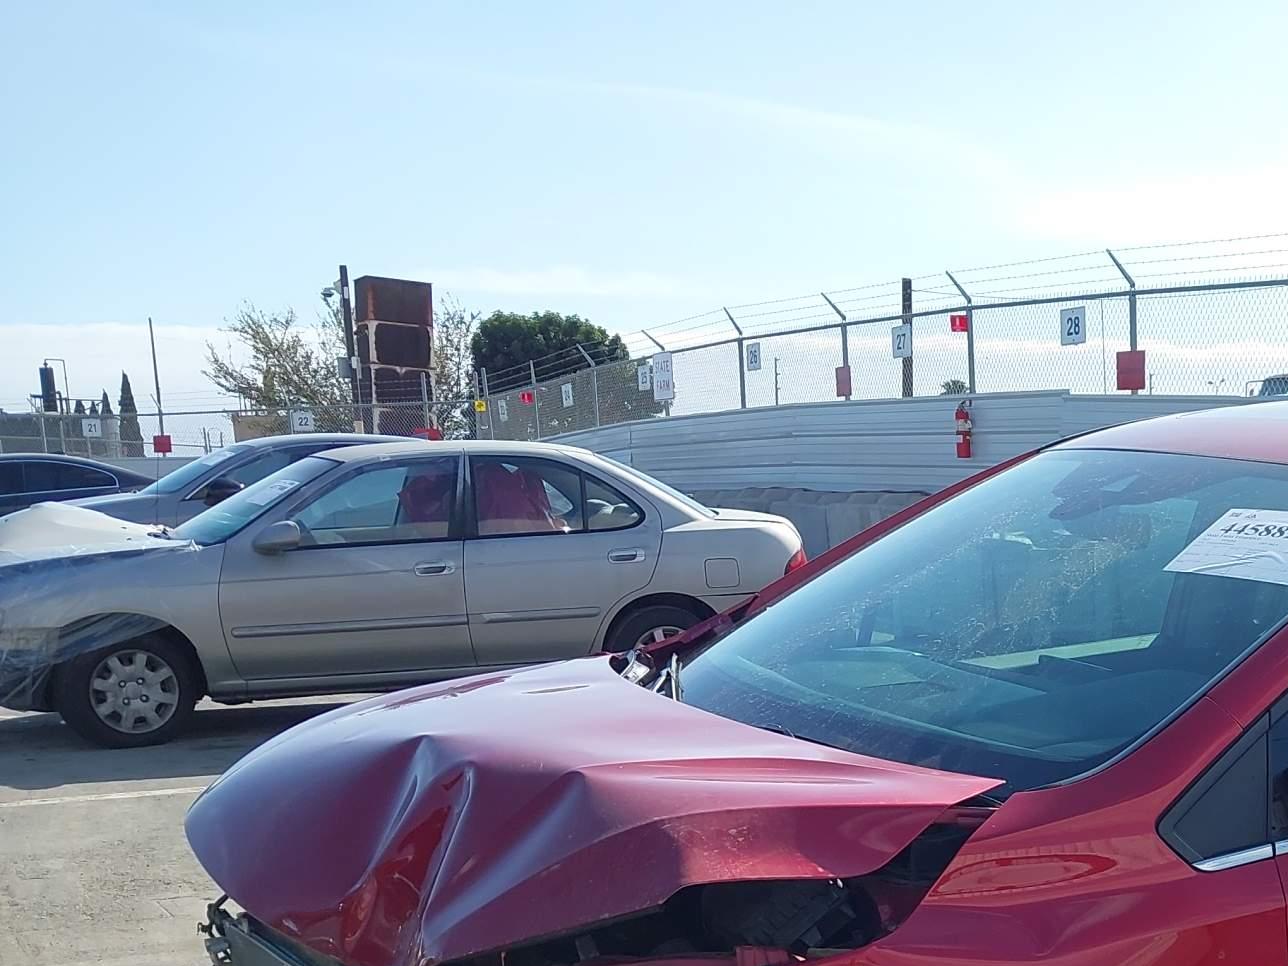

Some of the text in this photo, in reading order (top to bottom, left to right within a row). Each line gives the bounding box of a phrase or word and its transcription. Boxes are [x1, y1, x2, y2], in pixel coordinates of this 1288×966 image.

[1066, 316, 1080, 337] 28
[896, 333, 907, 350] 27
[749, 349, 758, 365] 26
[654, 359, 671, 374] STATE
[656, 378, 671, 393] FARM
[87, 423, 98, 433] 21
[297, 416, 310, 427] 22
